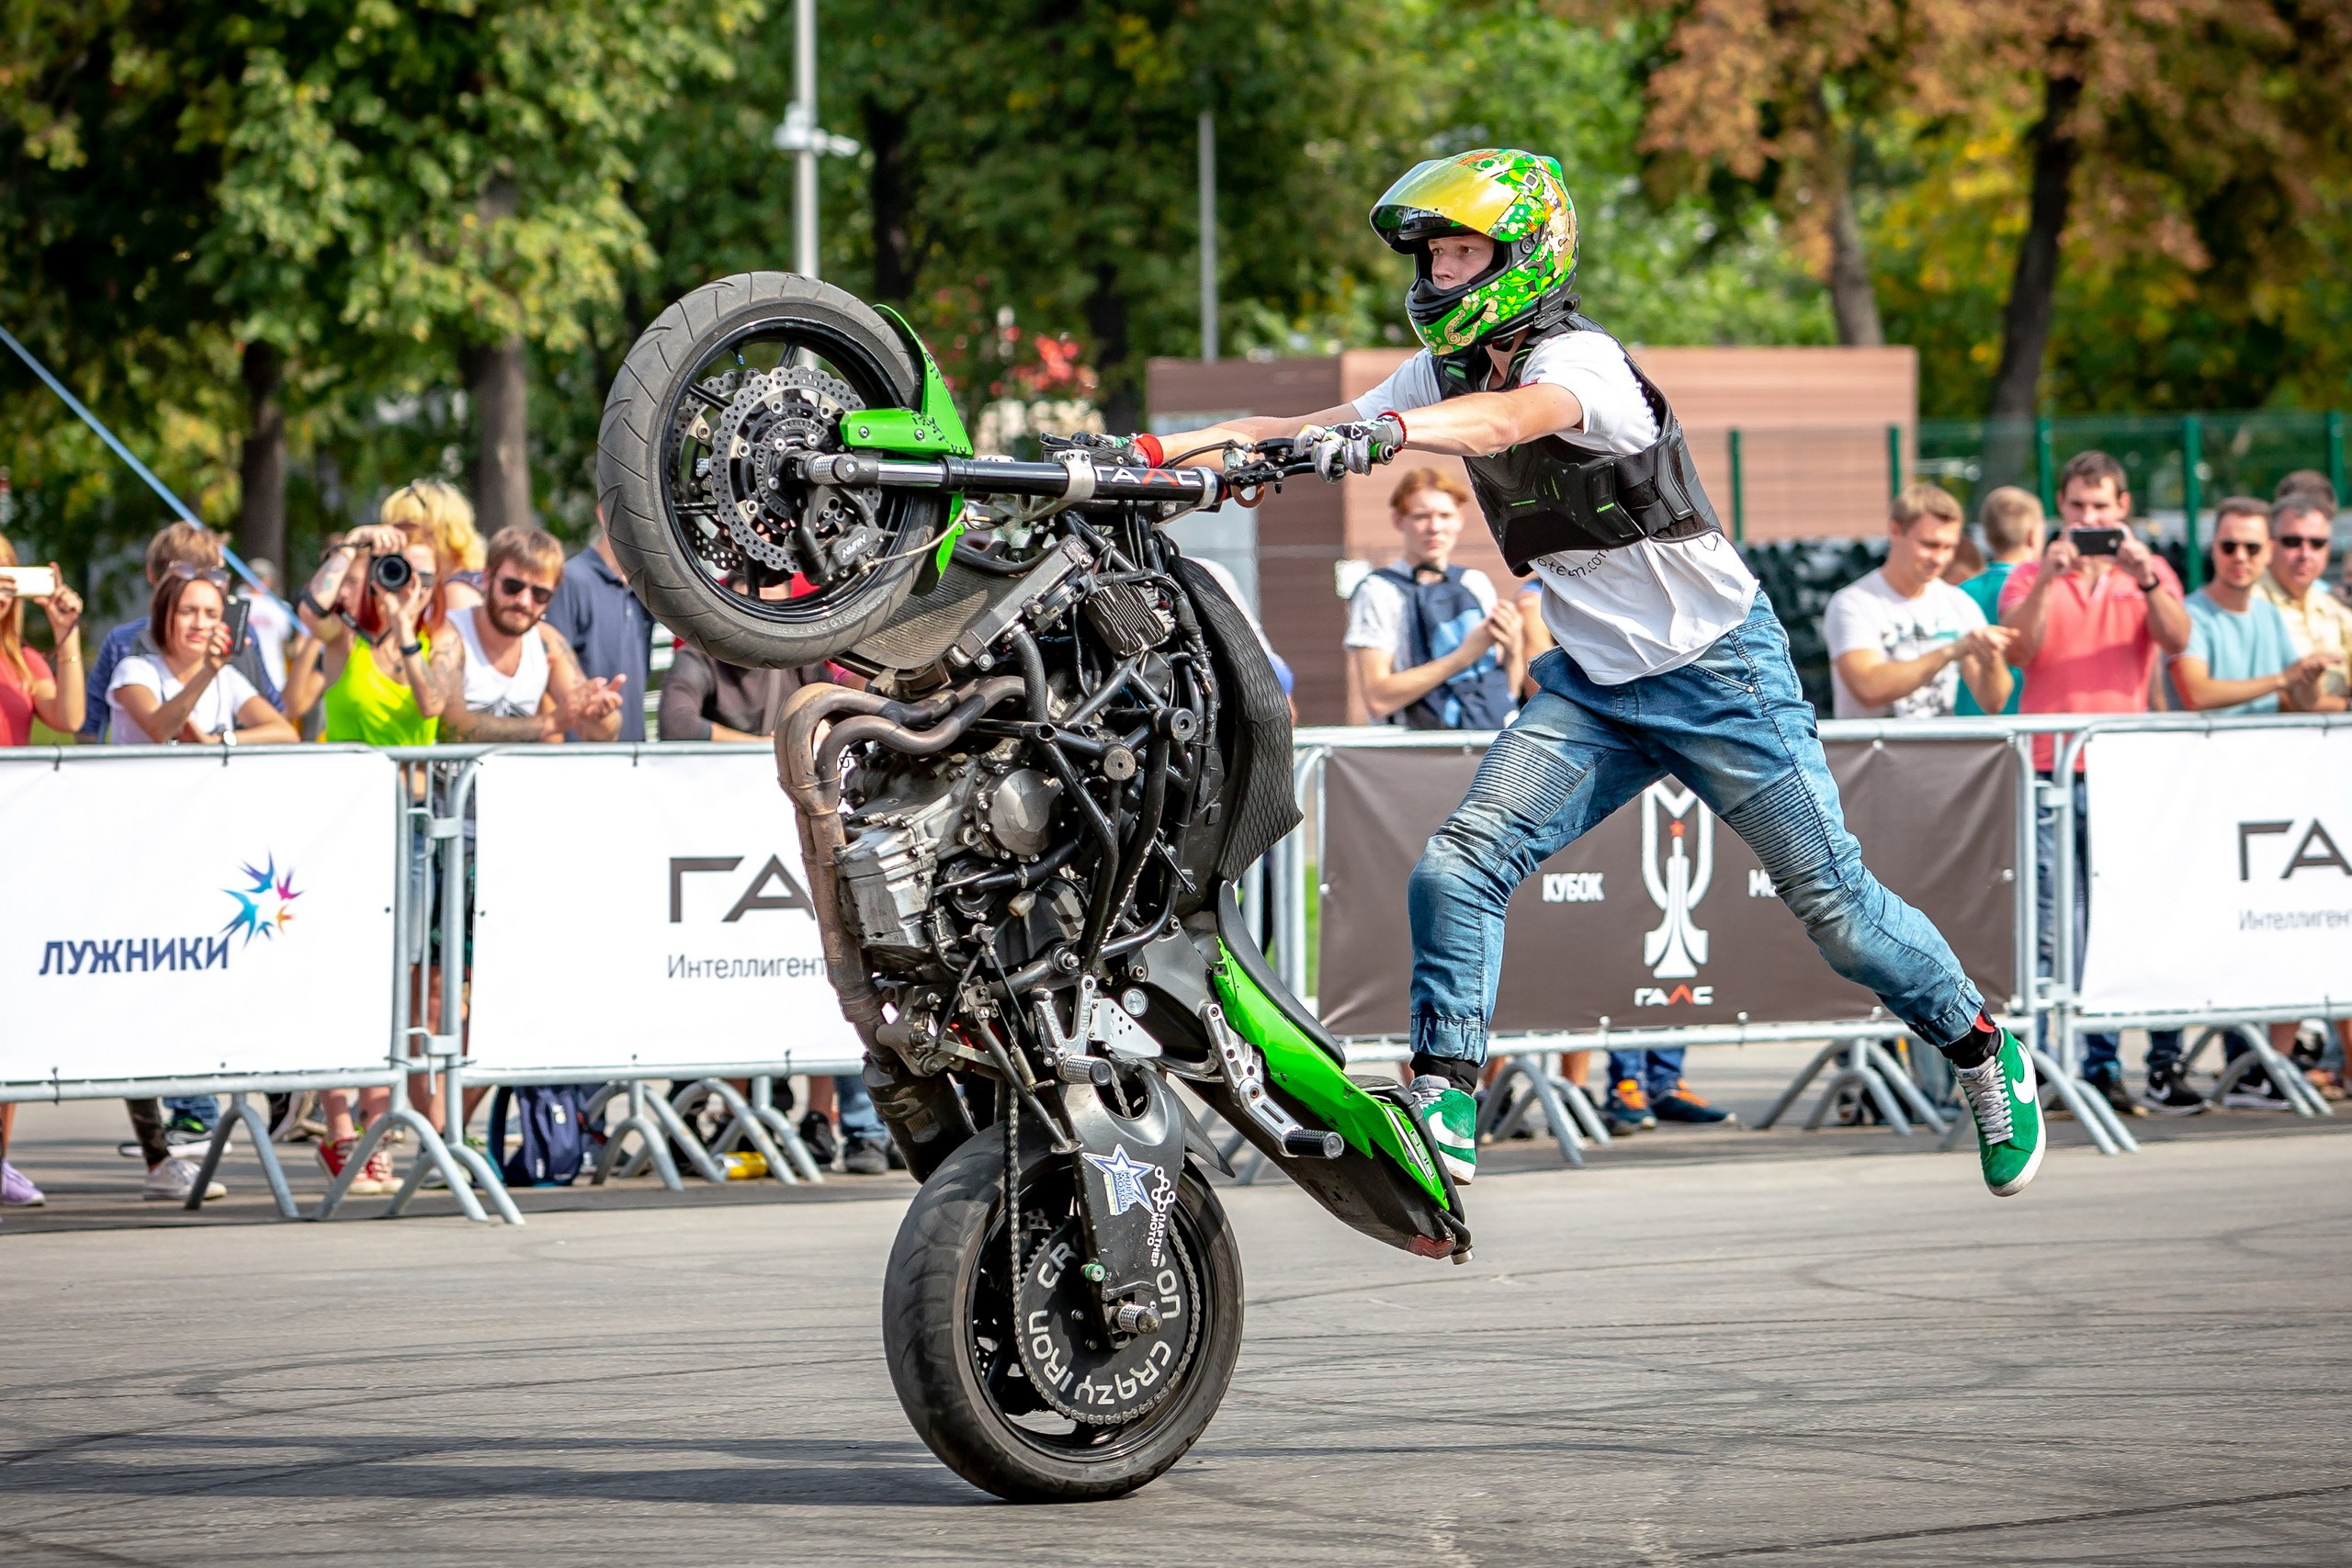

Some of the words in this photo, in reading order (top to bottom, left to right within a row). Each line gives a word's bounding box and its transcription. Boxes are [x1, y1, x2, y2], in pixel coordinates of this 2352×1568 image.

[1543, 872, 1605, 903] КУБОК
[39, 935, 231, 976] ЛУЖНИКИ
[1114, 1171, 1127, 1210] MOTOR
[1124, 1170, 1136, 1201] MULTI
[1147, 1213, 1159, 1247] МОТО
[1150, 1213, 1167, 1268] ПАРТНЕР
